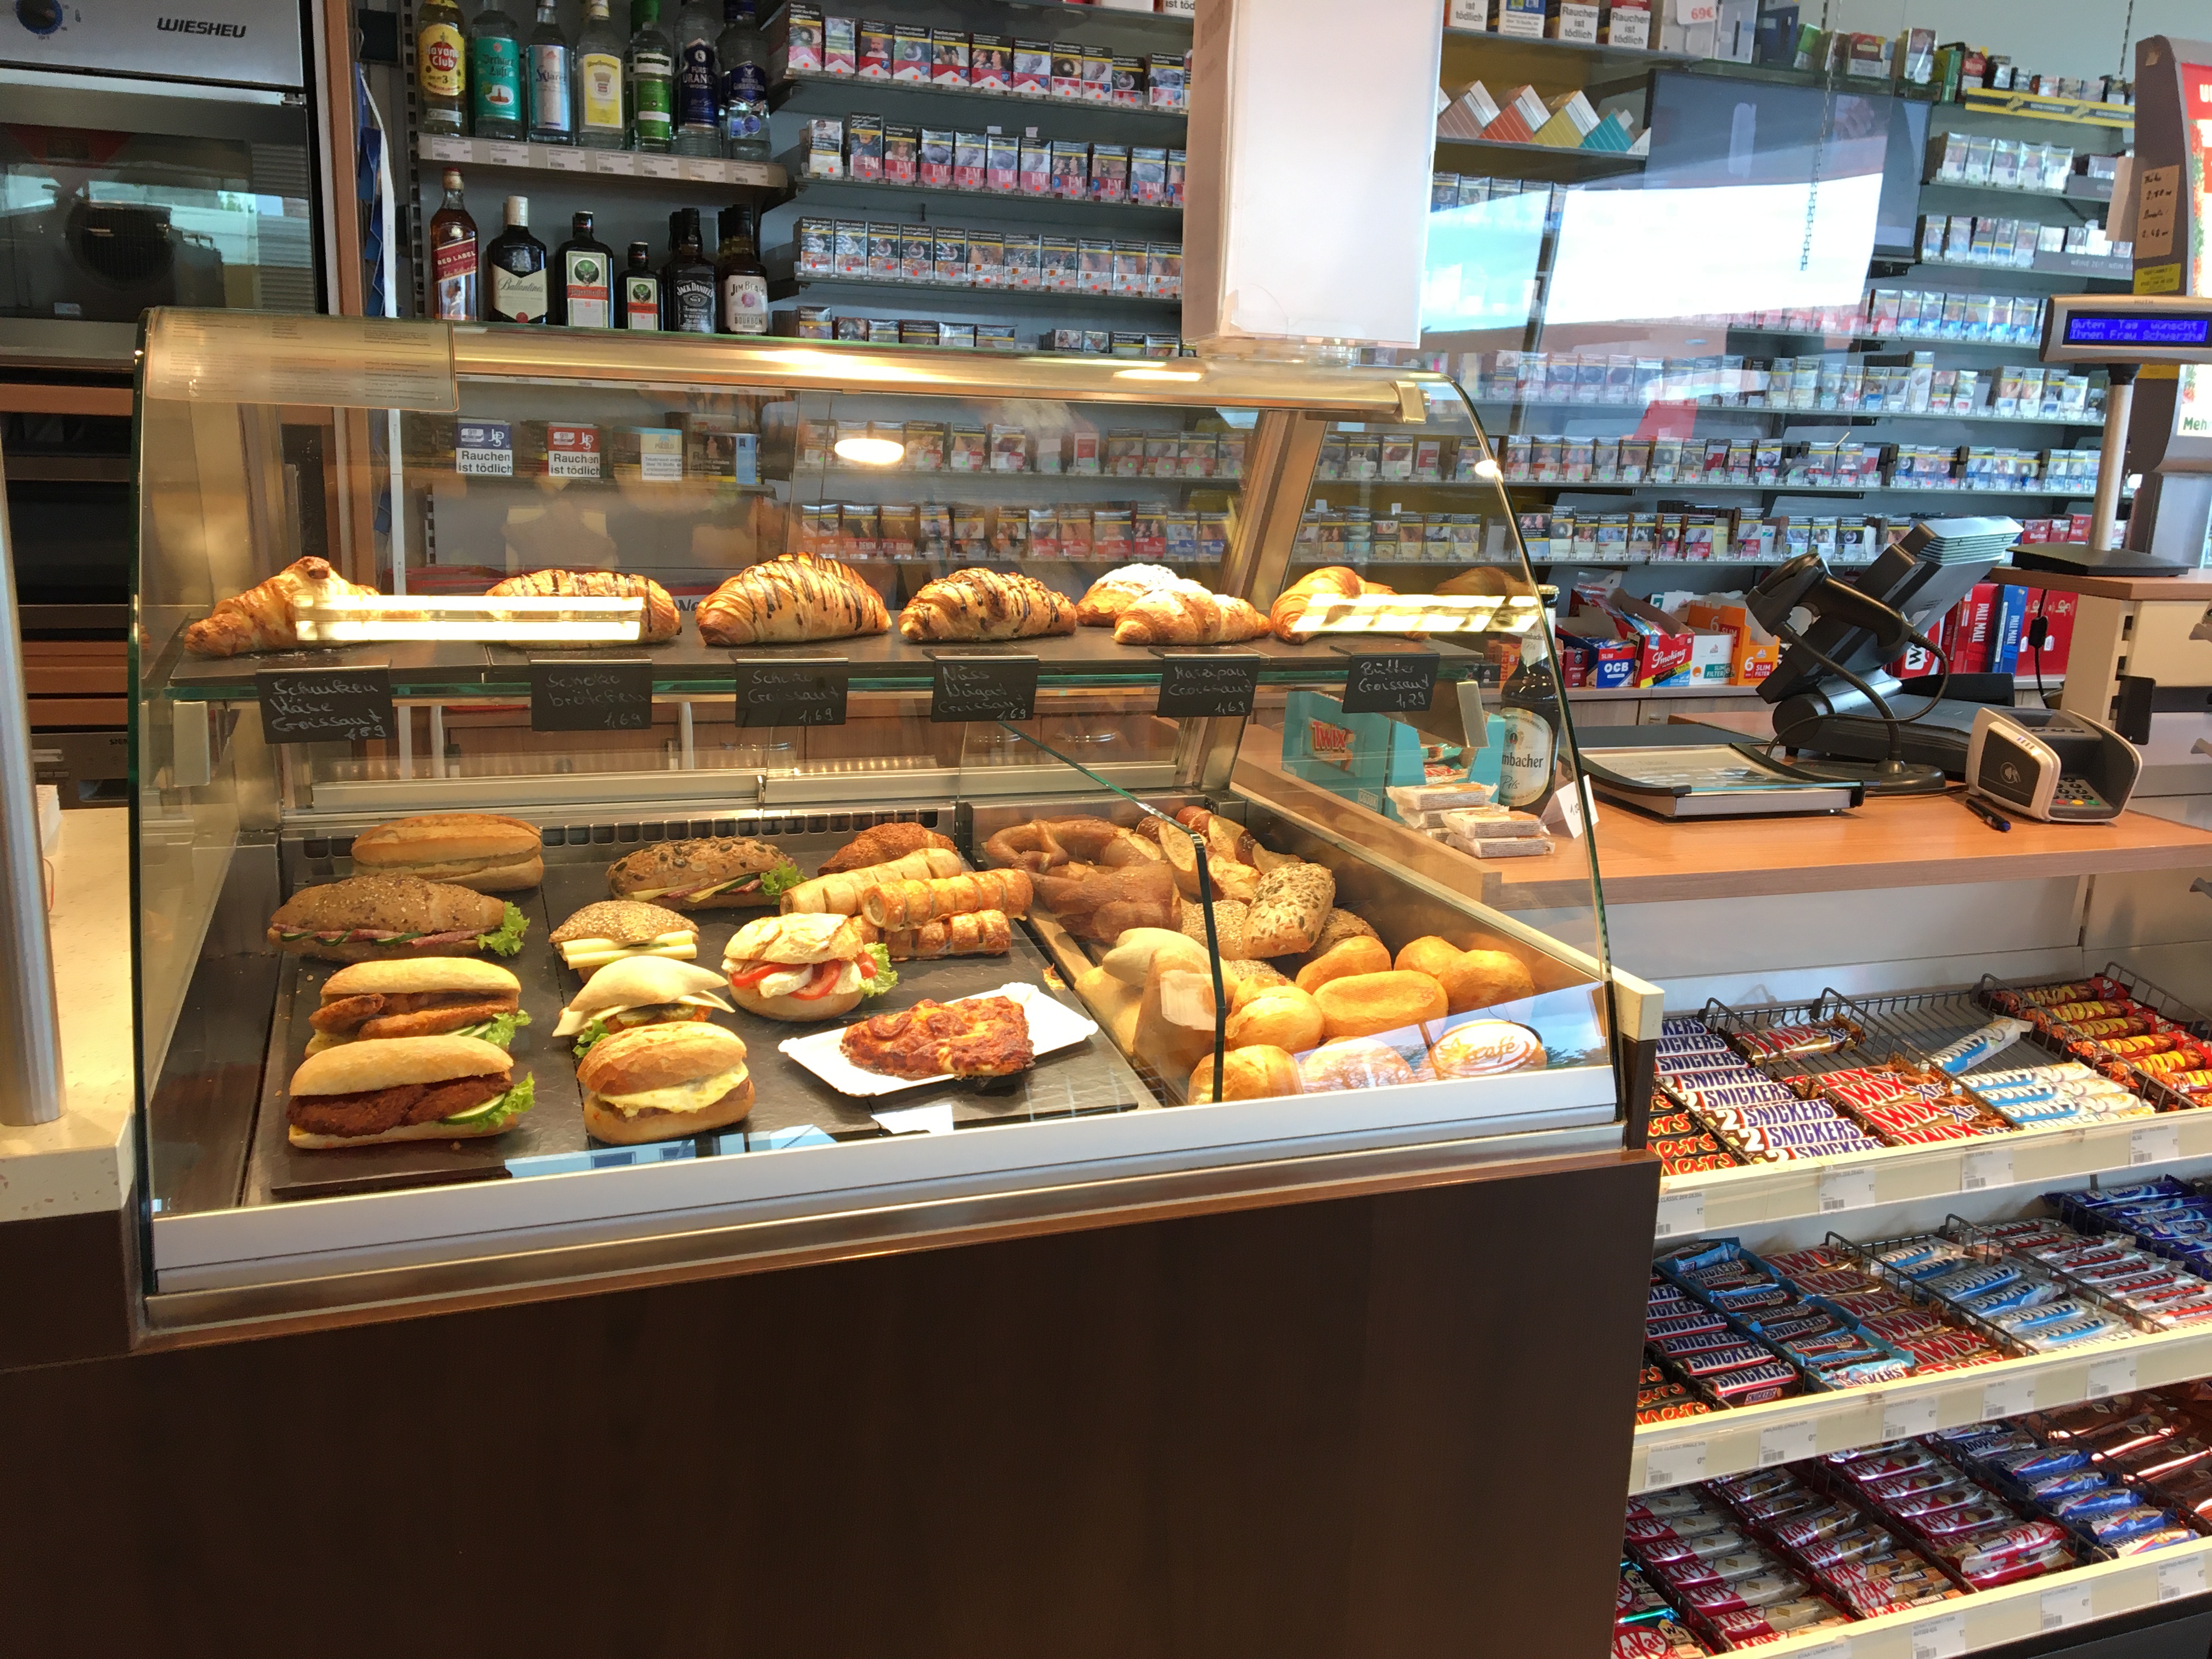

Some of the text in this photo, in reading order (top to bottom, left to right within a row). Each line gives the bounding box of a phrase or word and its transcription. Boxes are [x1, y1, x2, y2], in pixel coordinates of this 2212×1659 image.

[1465, 1, 1475, 10] ist
[1562, 6, 1597, 19] Rauchen
[1691, 7, 1713, 20] 69€
[1455, 10, 1483, 22] tödlich
[1574, 19, 1584, 28] ist
[1612, 12, 1648, 24] Rauchen
[157, 17, 246, 38] WIESHEU
[1564, 27, 1592, 39] tödlich
[1625, 24, 1635, 33] ist
[1613, 34, 1644, 44] tödlich
[426, 46, 460, 58] Havana
[432, 57, 454, 67] Club
[437, 251, 476, 266] RED LABEL
[731, 284, 743, 296] JIM
[734, 317, 763, 325] BOURBON
[2072, 320, 2105, 330] Guten
[2118, 321, 2138, 330] Tag
[2070, 330, 2104, 340] Ihnen
[2109, 330, 2137, 341] Frau
[461, 450, 510, 461] Rauchen
[554, 454, 599, 464] Rauchen
[459, 462, 512, 473] ist tödlich
[551, 465, 564, 473] ist
[859, 541, 877, 550] DENIM
[1709, 616, 1719, 631] 6
[1972, 603, 1990, 643] PALL MALL
[2006, 615, 2020, 645] PALL MALL
[1651, 648, 1687, 669] Smoking
[1745, 656, 1754, 672] 6
[1174, 665, 1248, 681] Marzipan
[1359, 661, 1415, 676] Butter
[1604, 662, 1629, 673] OCB
[1168, 682, 1254, 697] Croissant
[1358, 673, 1431, 693] Croissant
[748, 685, 840, 704] Croissant
[1395, 692, 1426, 708] 1,29
[799, 708, 834, 723] 1,69
[996, 707, 1026, 721] 1,69
[1214, 699, 1246, 715] 1,69
[272, 708, 382, 732] Croissant
[603, 713, 642, 728] 1,69
[1502, 752, 1544, 768] mbacher
[2051, 1000, 2106, 1022] LION
[1661, 1018, 1705, 1035] KERS
[1656, 1034, 1726, 1054] NICKERS
[1734, 1024, 1821, 1053] TWIX
[2100, 1035, 2156, 1054] LION
[1474, 1035, 1520, 1063] café
[1660, 1051, 1747, 1073] SNICKERS
[2133, 1049, 2186, 1073] LION
[1684, 1068, 1771, 1091] SNICKERS
[1707, 1082, 1794, 1108] SNICKERS
[1825, 1076, 1917, 1109] TWIX
[1716, 1098, 1835, 1131] 2 SNICKERS
[1859, 1099, 1950, 1132] TWIX
[1648, 1113, 1692, 1137] ars
[1738, 1119, 1861, 1152] 2 SNICKERS
[1648, 1132, 1718, 1159] ars
[1761, 1246, 1842, 1277] TWIX
[1791, 1270, 1869, 1295] TWIX
[1948, 1265, 2014, 1291] BOUNTY
[1724, 1290, 1787, 1308] SNICKERS
[1970, 1280, 2036, 1310] BOUNTY
[1647, 1313, 1726, 1336] SNICKERS
[1766, 1314, 1831, 1340] SNICKERS
[1861, 1312, 1941, 1341] TWIX
[2029, 1317, 2106, 1341] BOUNTY
[1666, 1331, 1748, 1352] SNICKERS
[1793, 1333, 1856, 1350] SNICKERS
[1893, 1329, 1990, 1365] TWIX
[1692, 1344, 1772, 1370] SNICKERS
[1719, 1362, 1794, 1388] SNICKERS
[1747, 1390, 1776, 1403] SNICKERS
[1824, 1561, 1865, 1588] KitKat
[1893, 1571, 1923, 1584] CHUNKY
[1848, 1577, 1893, 1609] KitKat
[1912, 1594, 1944, 1605] CHUNKY
